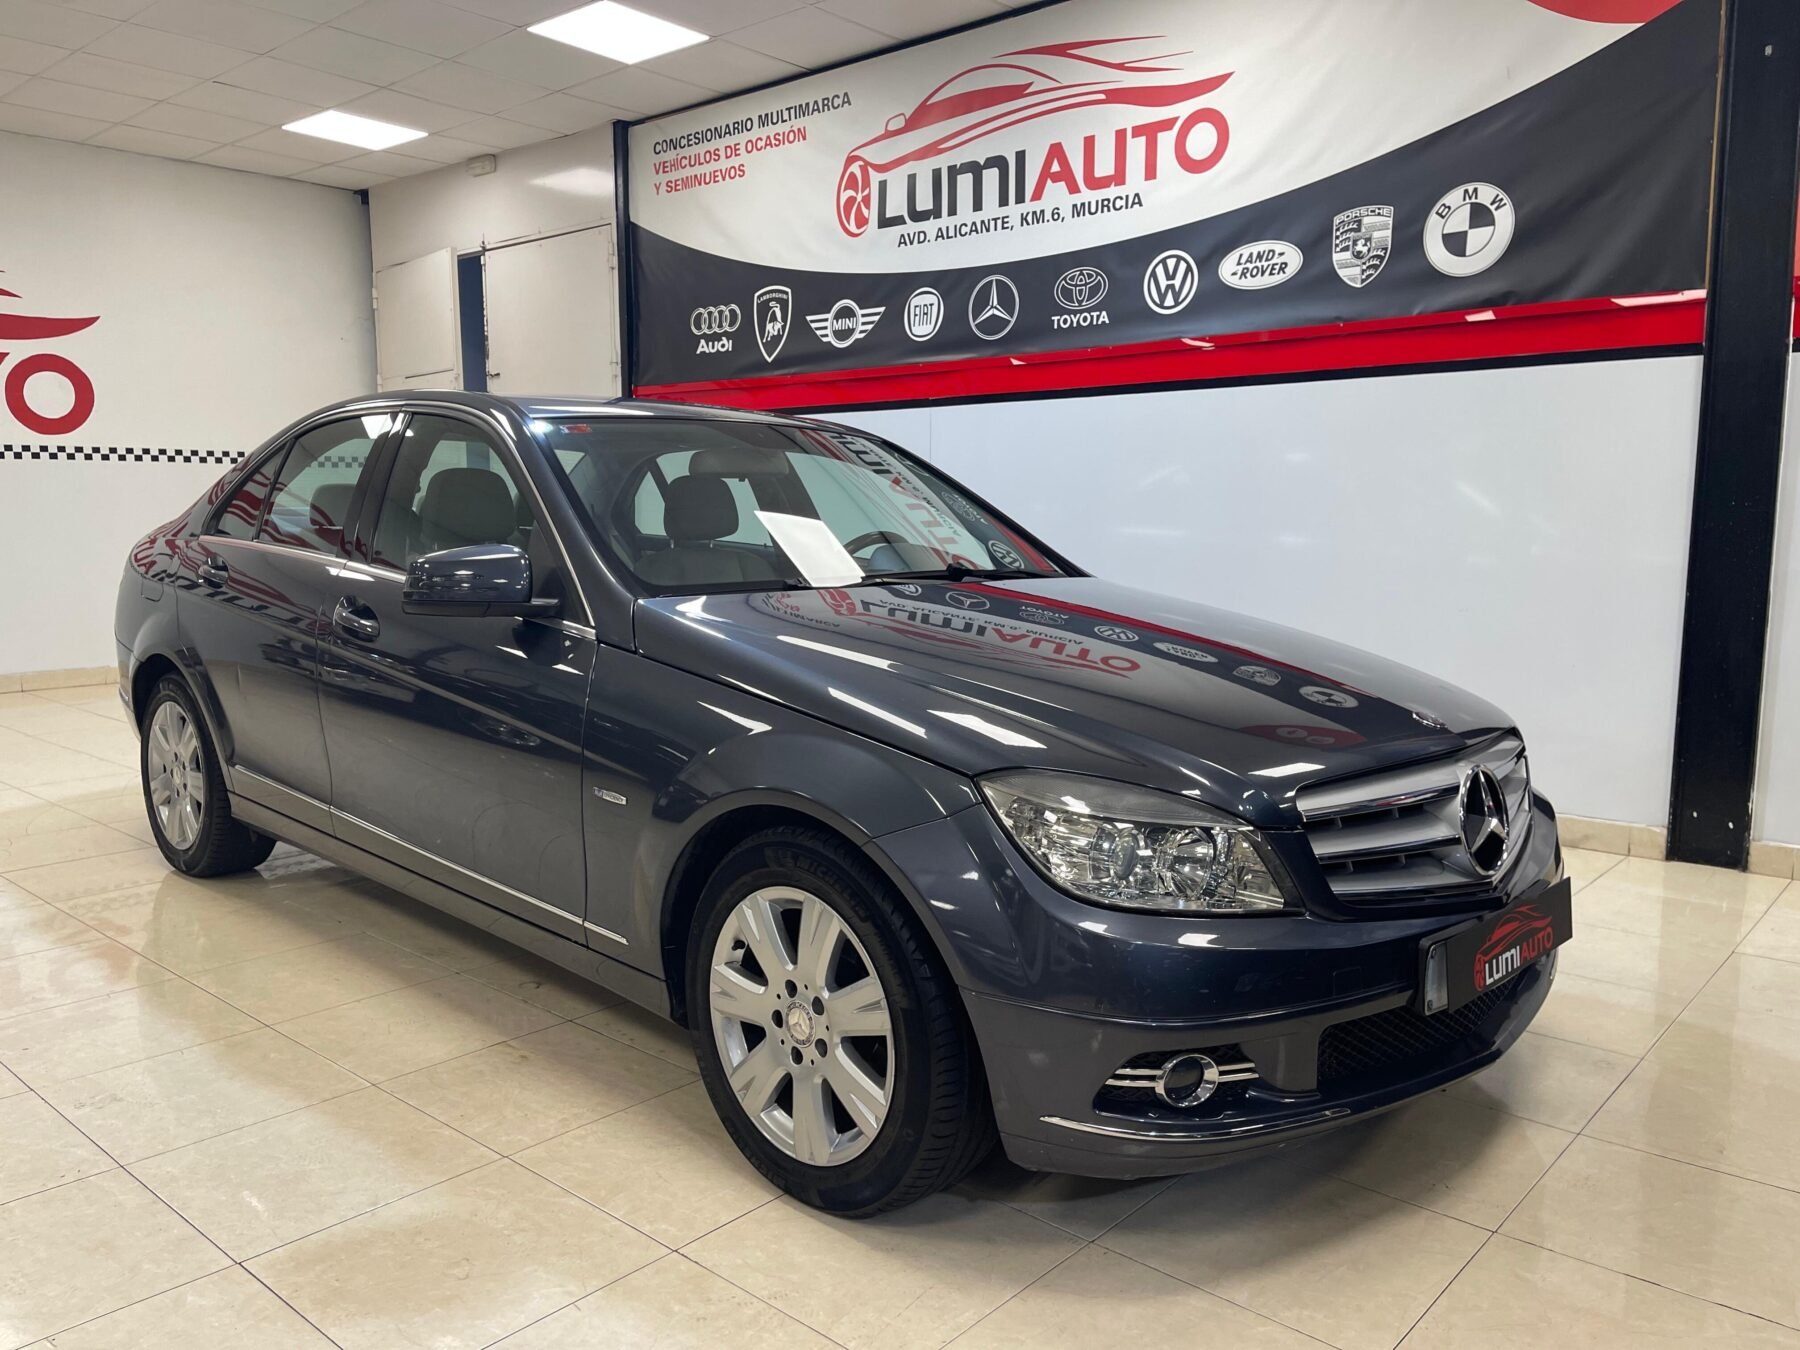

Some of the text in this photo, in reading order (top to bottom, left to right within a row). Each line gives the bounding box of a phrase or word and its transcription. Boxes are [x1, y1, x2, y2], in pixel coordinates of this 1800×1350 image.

[653, 91, 852, 156] CONCESIONARIO MULTIMARCA
[653, 125, 808, 176] VEHÍCULOS DE OCASIÓN
[654, 163, 746, 196] Y SEMINUEVOS
[877, 107, 1230, 230] LUMIAUTO
[897, 192, 1143, 248] AVD. ALICANTE, KM.6, MURCIA
[1335, 206, 1392, 226] PORSCHE
[1434, 187, 1507, 220] BMW
[832, 316, 857, 331] MINI
[913, 303, 934, 328] FIAT
[1051, 310, 1110, 330] TOYOTA
[696, 338, 733, 355] Audi
[1485, 927, 1553, 985] LUMIAUTO
